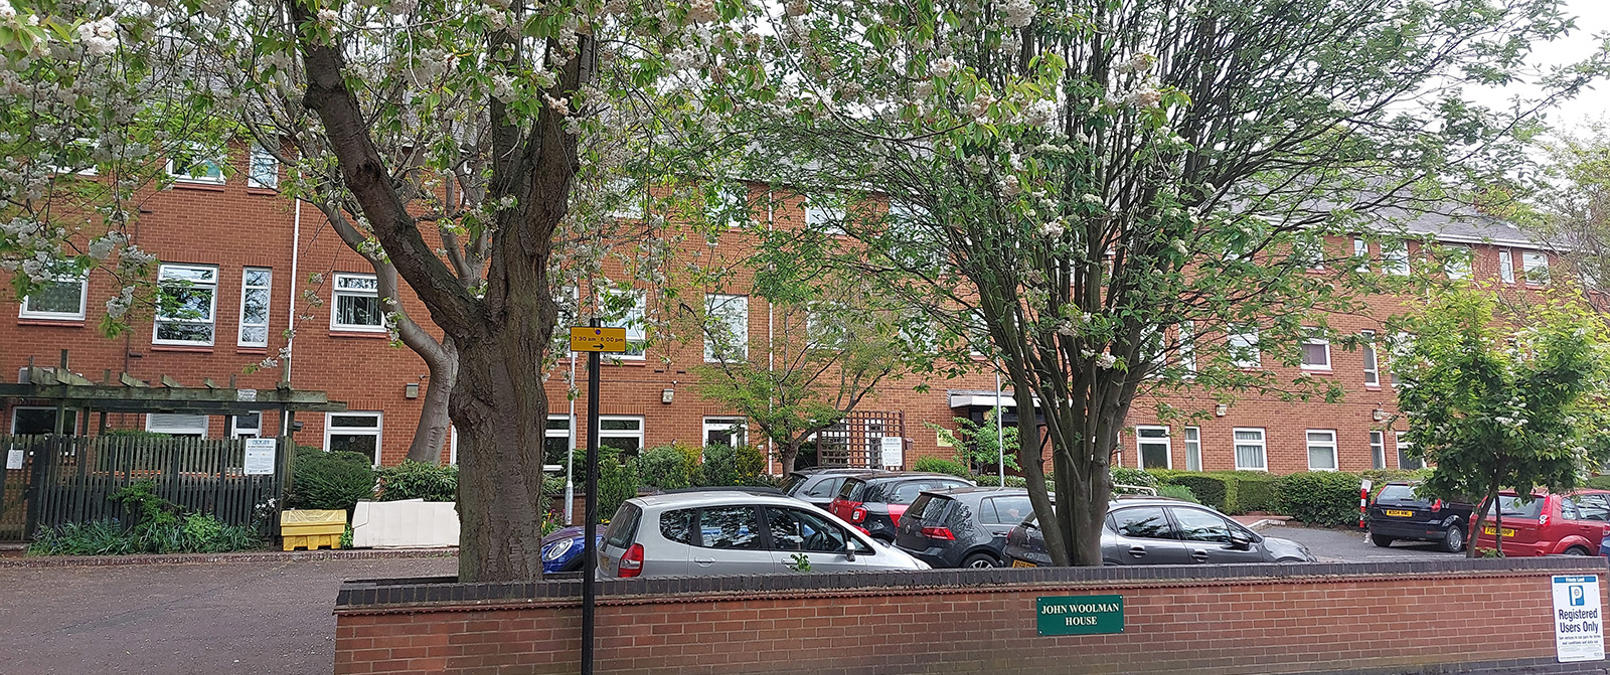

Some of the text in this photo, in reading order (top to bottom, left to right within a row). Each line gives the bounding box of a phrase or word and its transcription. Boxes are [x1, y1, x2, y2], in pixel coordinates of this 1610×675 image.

[1041, 603, 1120, 614] JOHN WOOLMAN
[1065, 616, 1098, 626] HOUSE
[1558, 608, 1598, 622] Registered
[1560, 621, 1599, 634] Users Only
